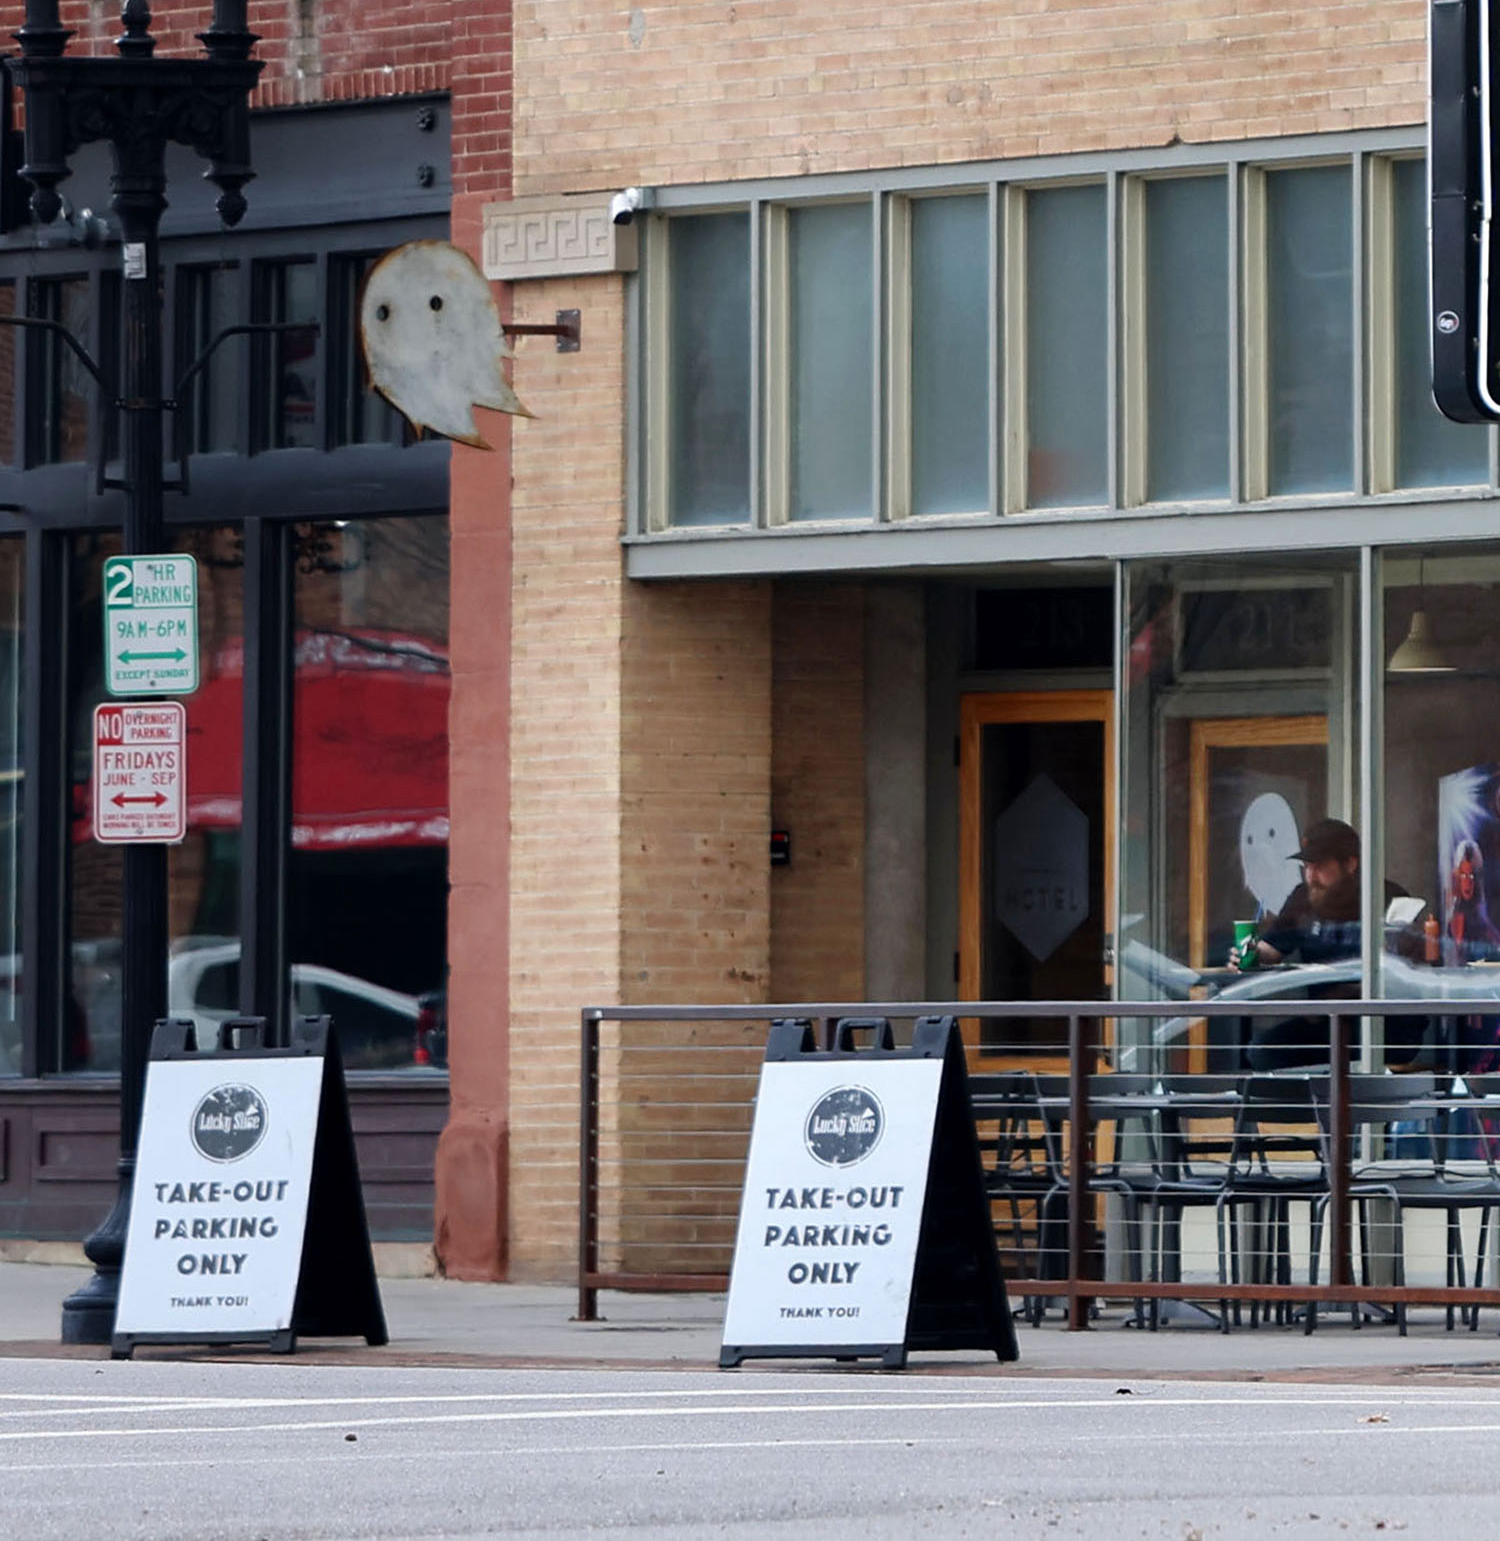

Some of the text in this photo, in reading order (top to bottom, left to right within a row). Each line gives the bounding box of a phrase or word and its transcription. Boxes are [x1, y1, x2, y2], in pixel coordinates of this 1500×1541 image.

[153, 564, 176, 580] HR
[106, 564, 133, 605] 2
[135, 585, 192, 604] PARKING
[117, 620, 187, 638] 9AM-6PM
[115, 668, 189, 680] EXCEPT SUNDAY
[99, 713, 122, 739] NO
[125, 713, 177, 725] OVERNIGHT
[131, 727, 172, 739] PARKING
[103, 751, 176, 770] FRIDAYS
[103, 772, 136, 786] JUNE
[151, 771, 177, 786] SEP
[199, 1111, 261, 1133] Lucky Slice
[813, 1114, 876, 1137] Lucky Slice
[154, 1180, 290, 1204] TAKE-OUT
[765, 1186, 905, 1210] TAKE-OUT
[154, 1216, 279, 1239] PARKING
[763, 1223, 893, 1247] PARKING
[176, 1253, 249, 1275] ONLY
[787, 1262, 861, 1284] ONLY
[170, 1295, 249, 1308] THANK YOU!
[779, 1306, 861, 1318] THANK YOU!
